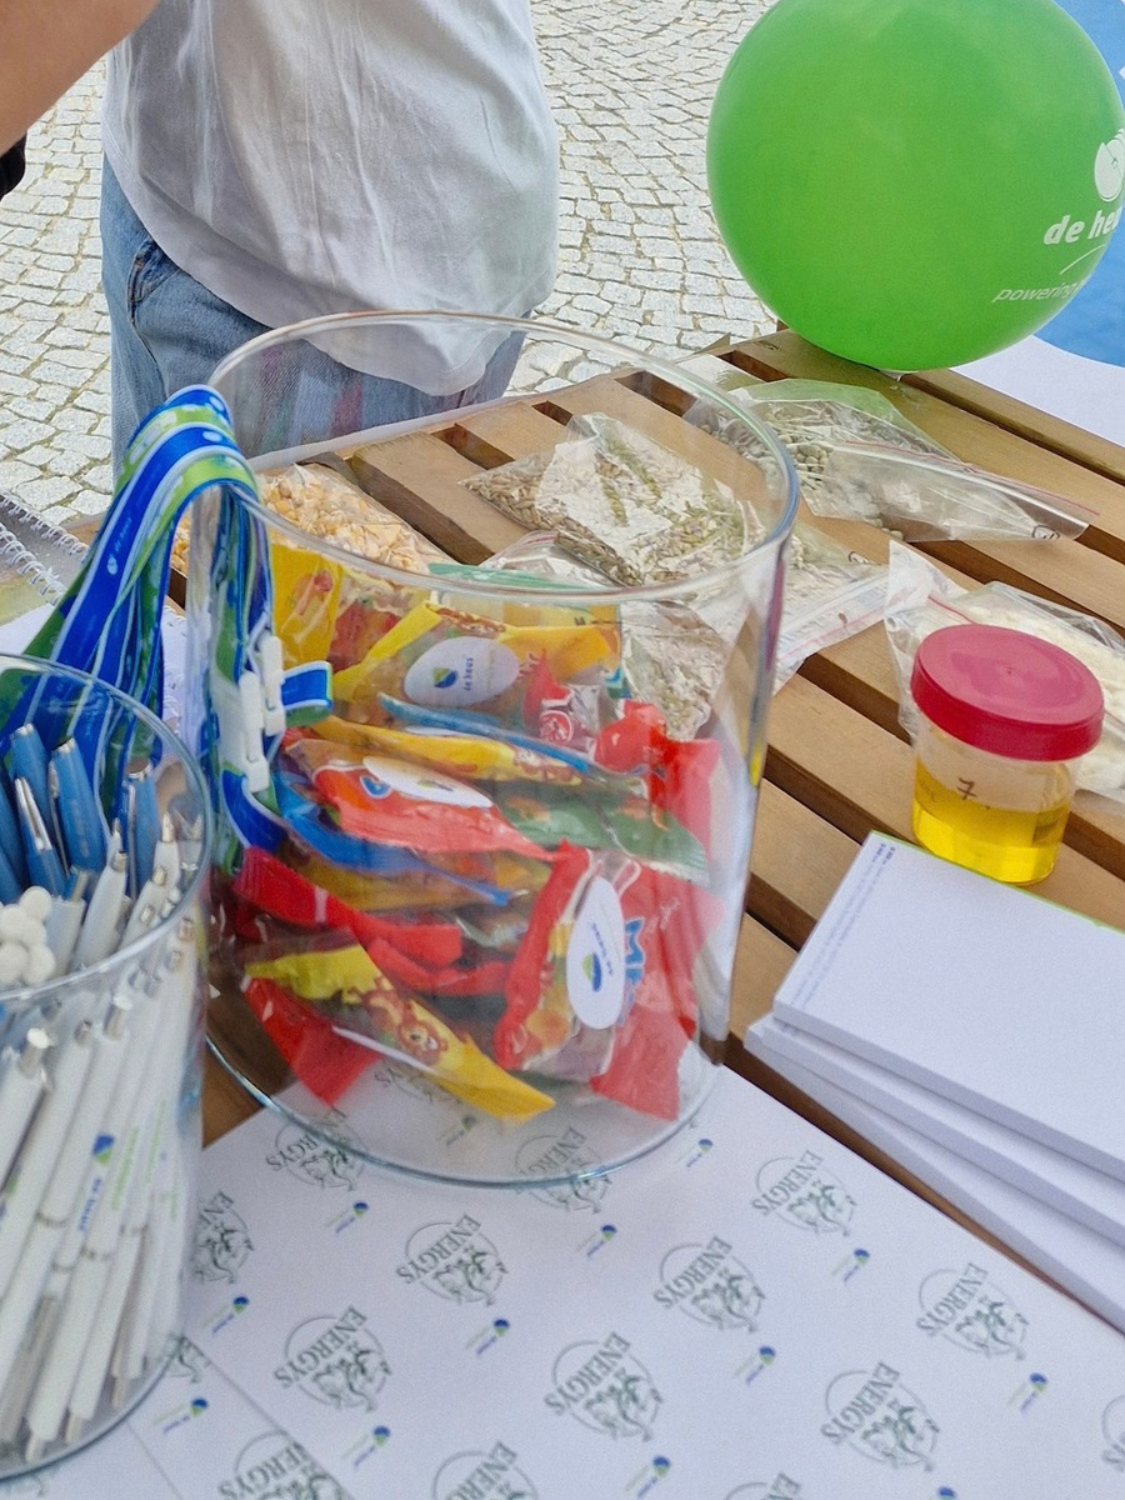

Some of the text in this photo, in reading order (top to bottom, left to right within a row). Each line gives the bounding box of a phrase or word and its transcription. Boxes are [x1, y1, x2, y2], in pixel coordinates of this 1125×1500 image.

[1043, 213, 1085, 245] de
[266, 1104, 348, 1173] ENRGYS
[751, 1150, 824, 1216] ENERGYS
[395, 1212, 482, 1285] ENERGYS
[653, 1235, 733, 1310] ENERGYS
[915, 1261, 989, 1336] ENERGYS
[273, 1304, 369, 1390] ENERGYS
[543, 1330, 632, 1416] ENERGYS
[820, 1361, 901, 1445] ENERGYS
